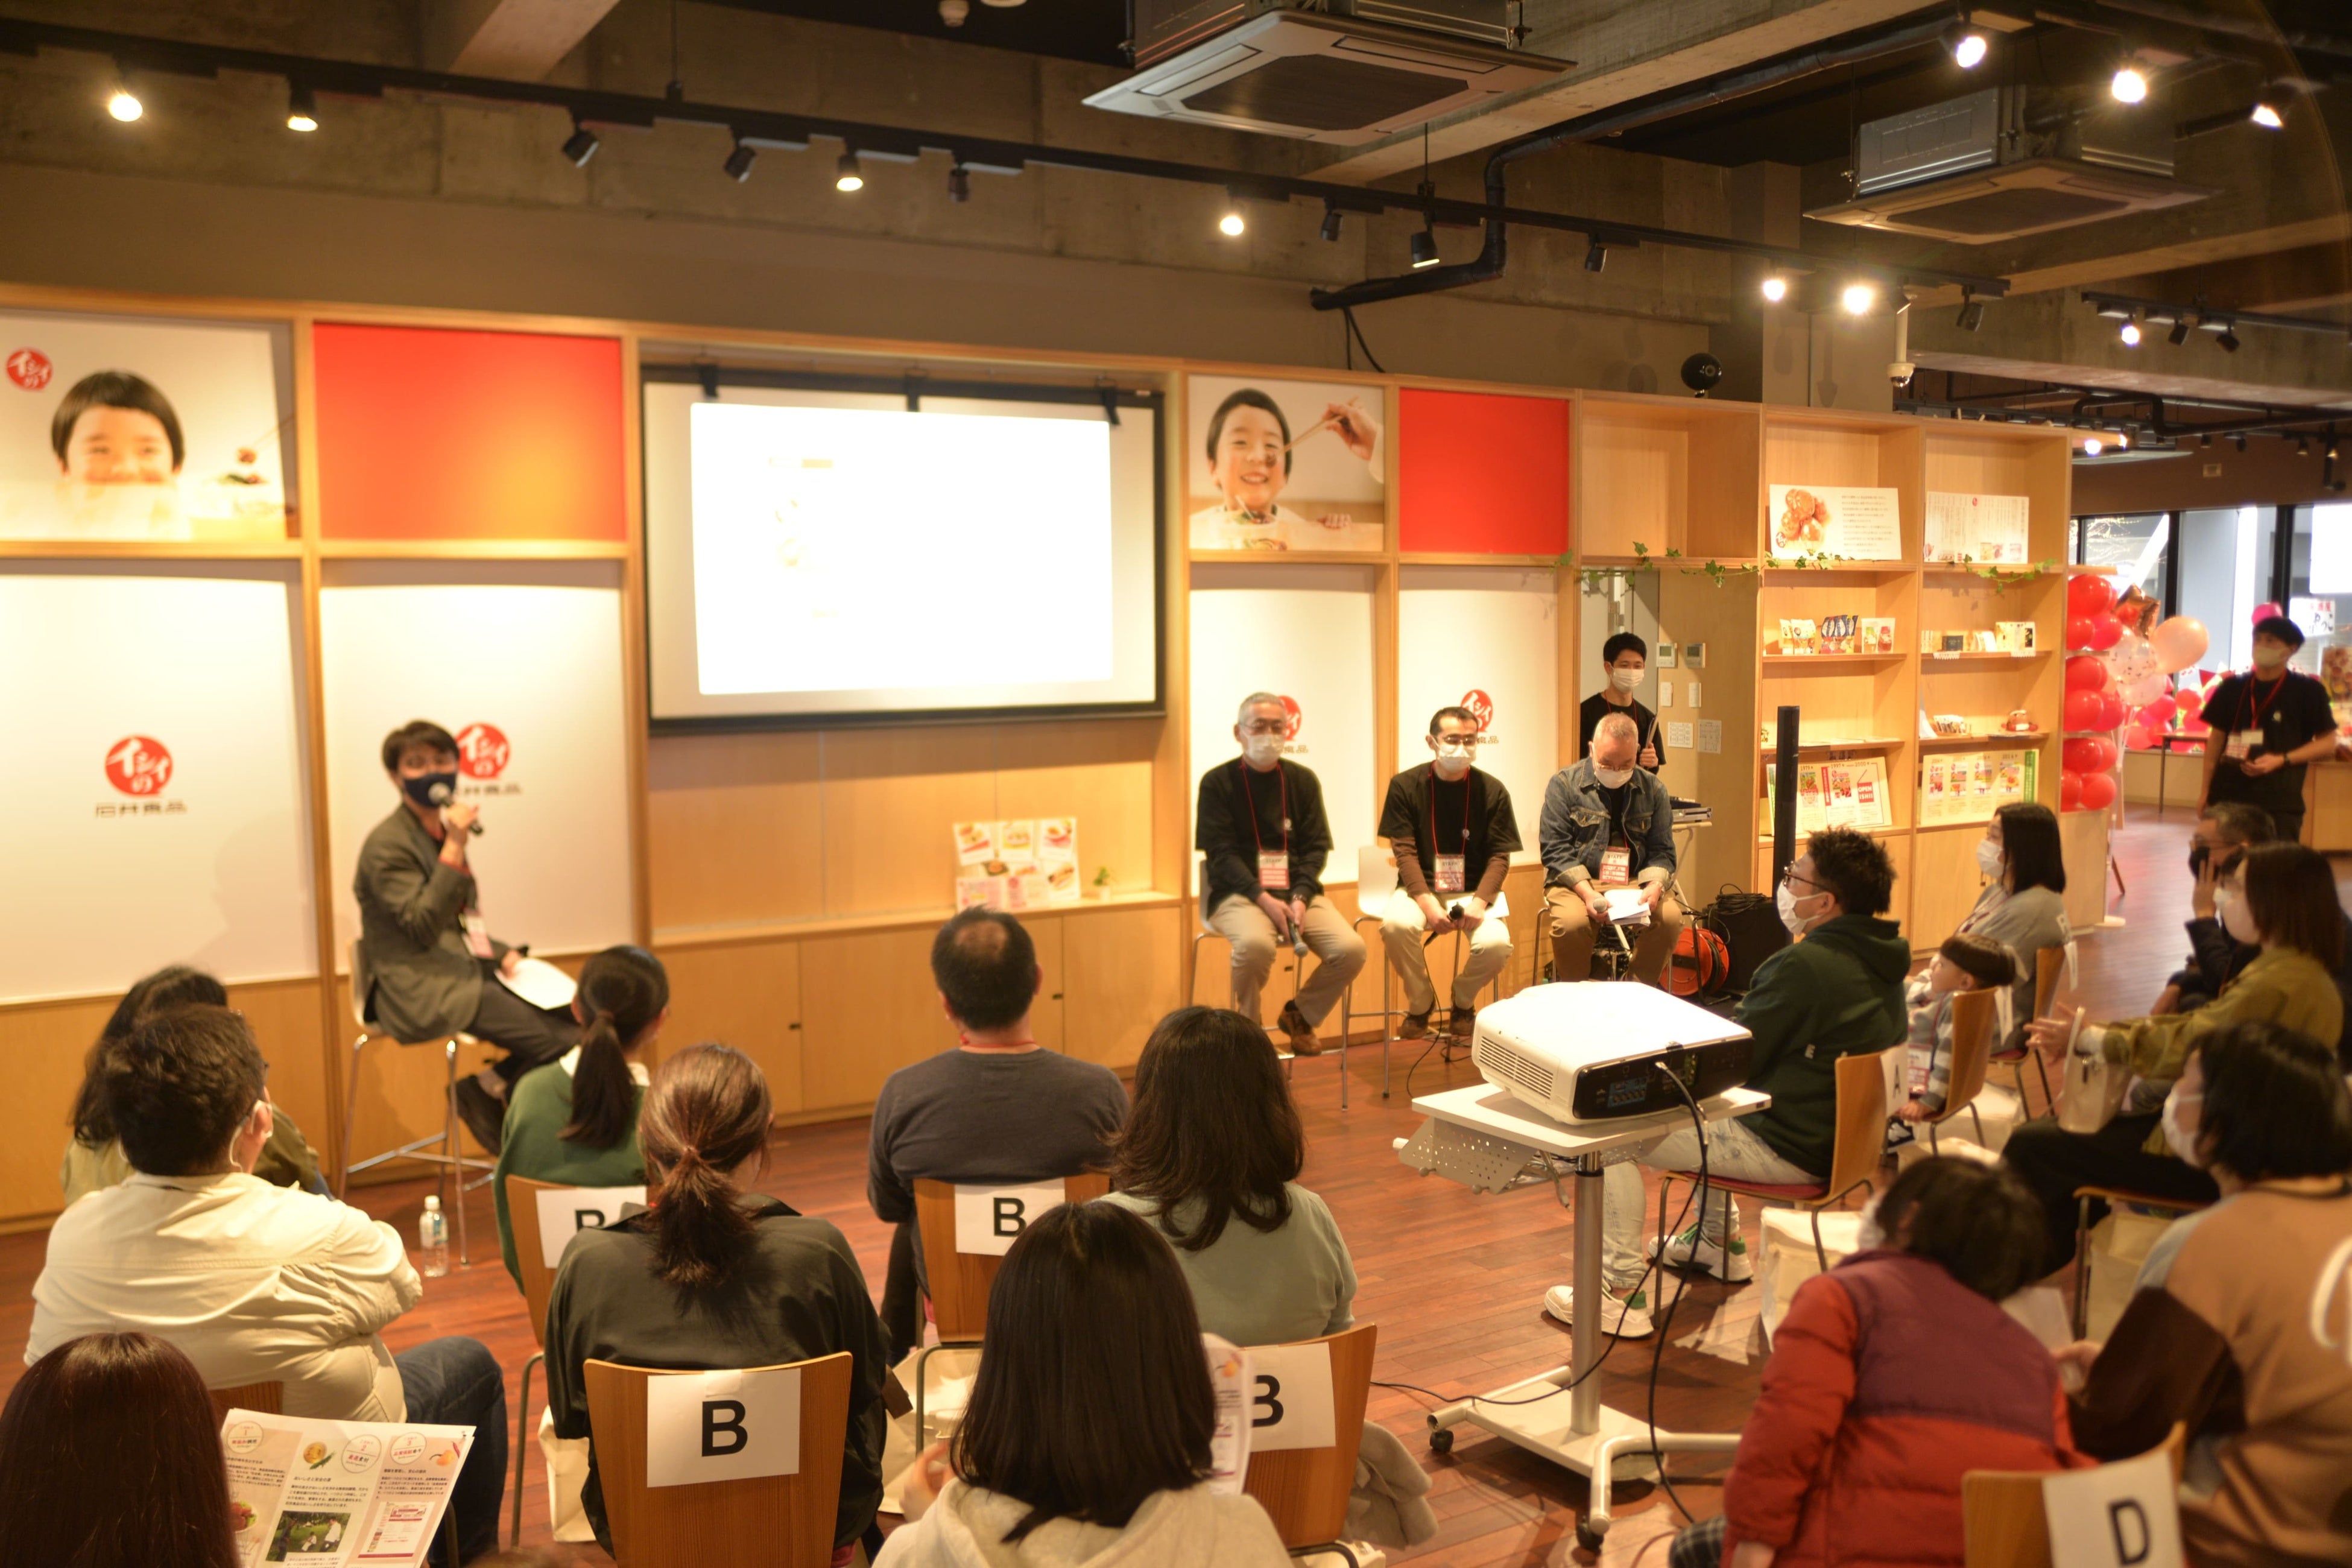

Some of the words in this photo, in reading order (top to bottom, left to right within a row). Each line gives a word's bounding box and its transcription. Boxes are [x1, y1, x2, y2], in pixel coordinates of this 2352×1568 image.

[993, 1197, 1027, 1237] B
[701, 1399, 748, 1457] B
[2109, 1500, 2150, 1565] D
